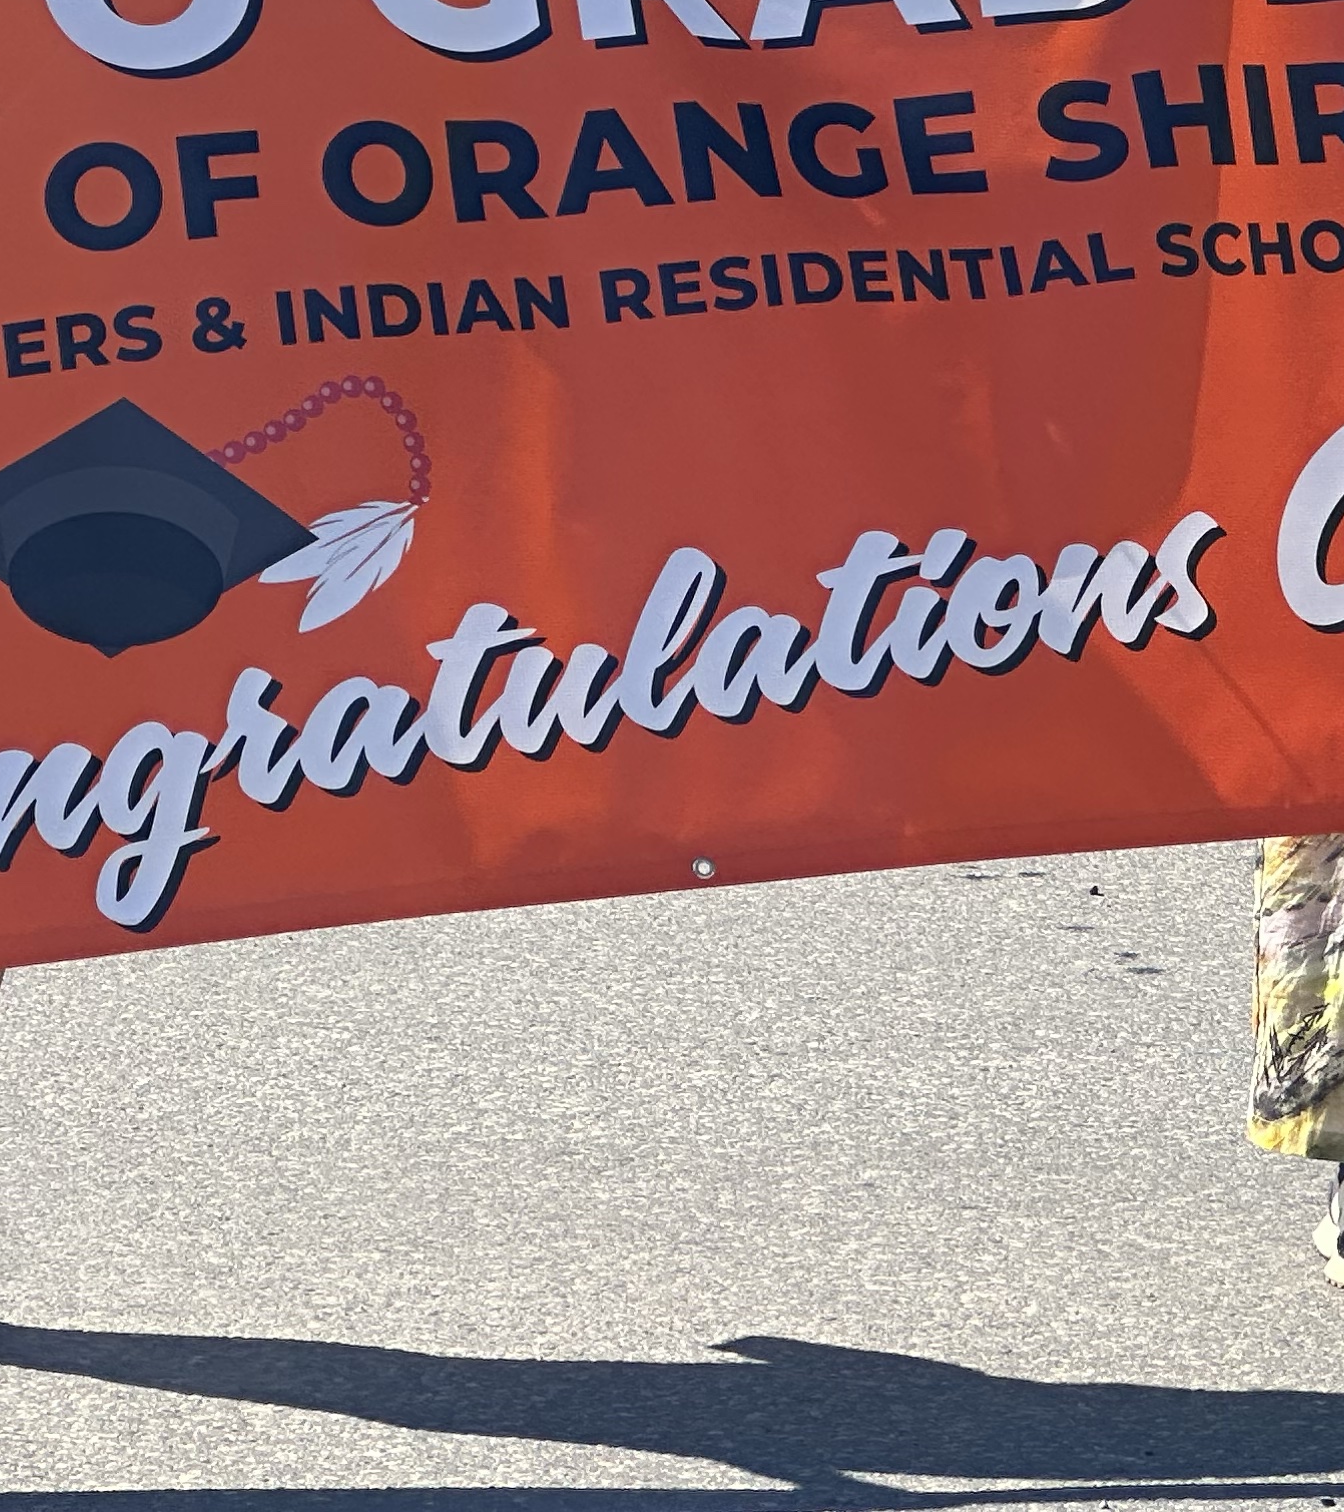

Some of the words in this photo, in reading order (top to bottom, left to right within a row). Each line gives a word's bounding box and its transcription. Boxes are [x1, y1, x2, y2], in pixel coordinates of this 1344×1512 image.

[44, 130, 260, 251] OF
[322, 90, 988, 227] ORANGE
[191, 296, 247, 353] &
[276, 275, 569, 346] INDIAN
[601, 232, 1135, 323] RESIDENTIAL
